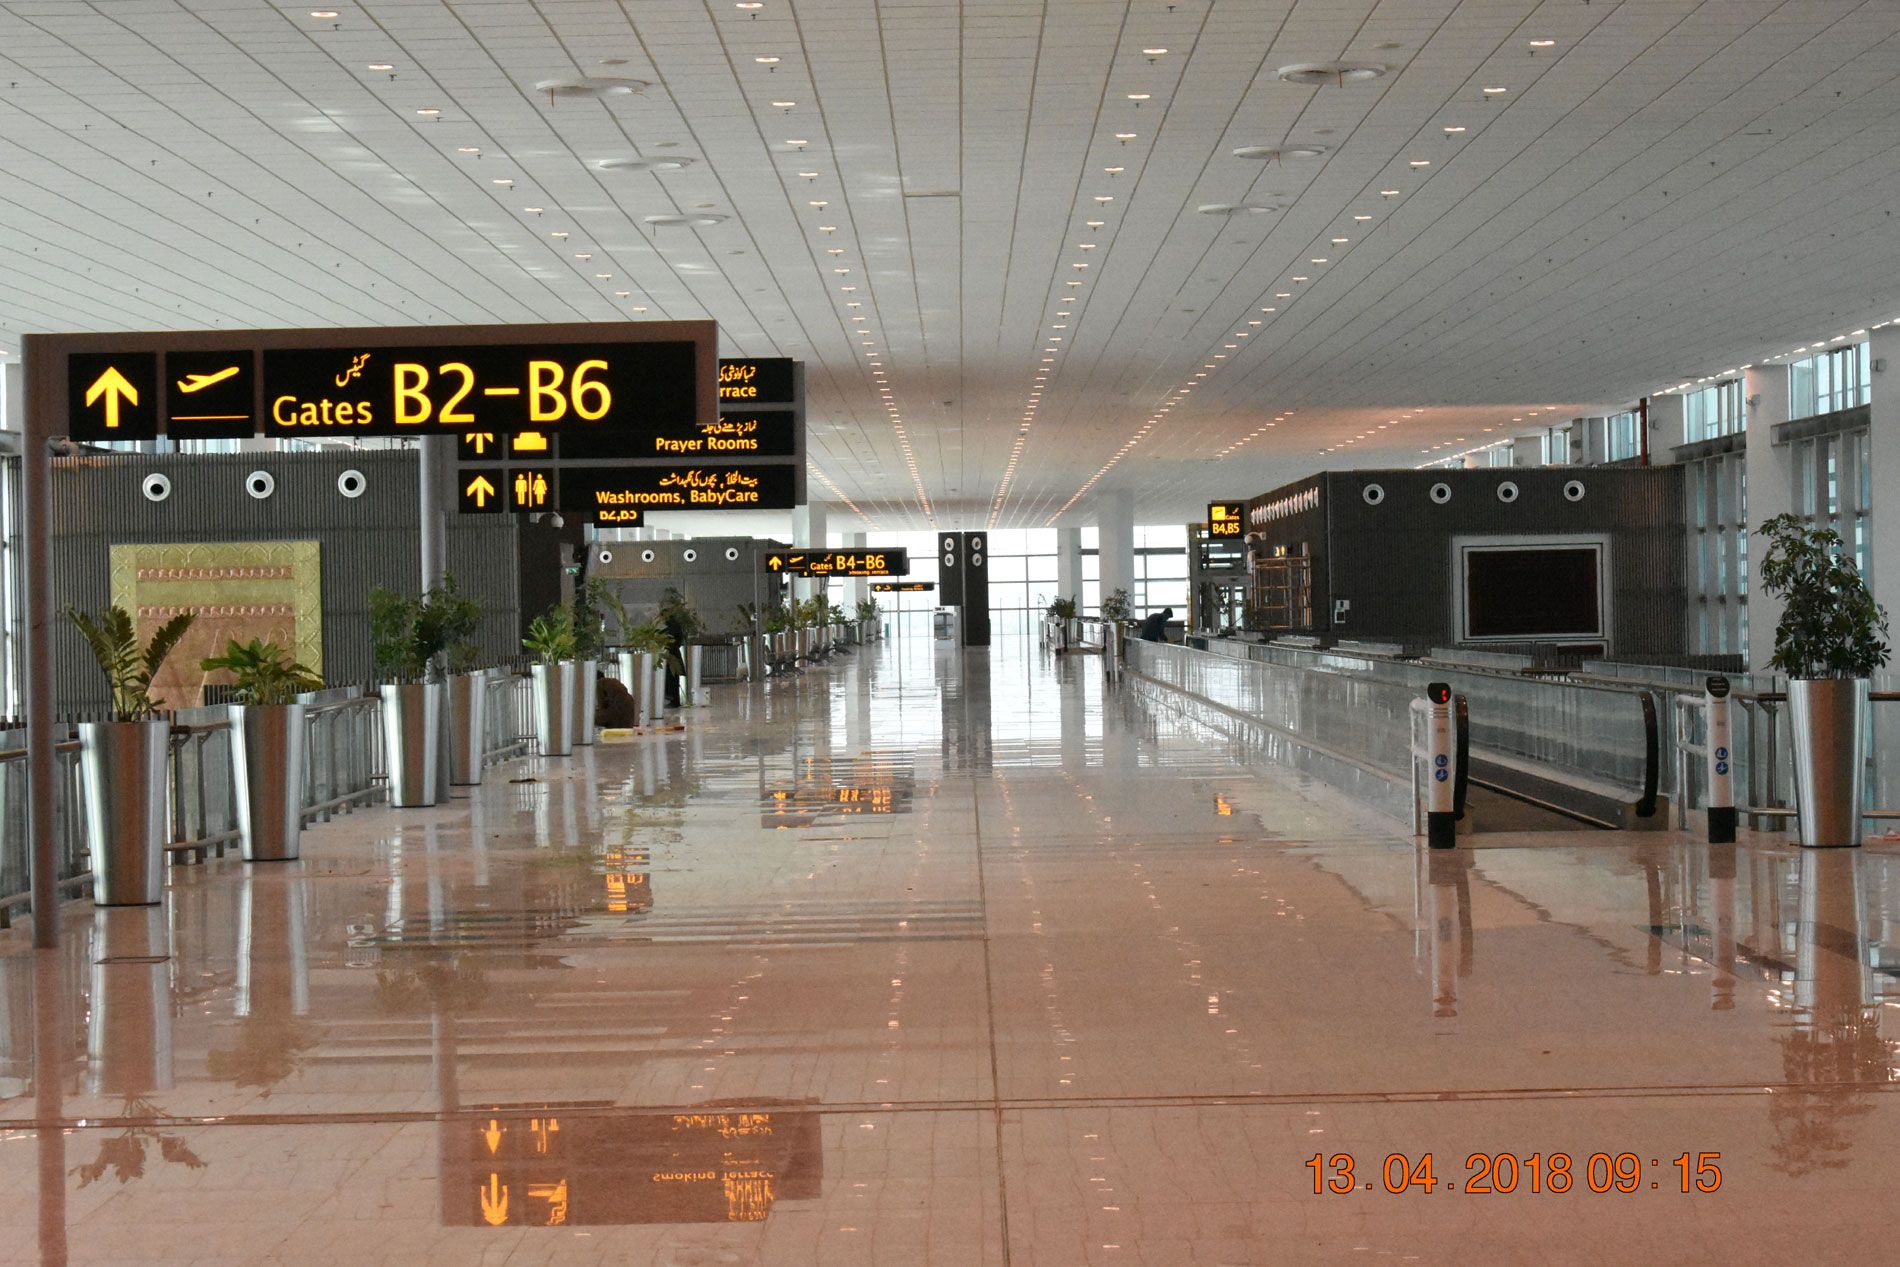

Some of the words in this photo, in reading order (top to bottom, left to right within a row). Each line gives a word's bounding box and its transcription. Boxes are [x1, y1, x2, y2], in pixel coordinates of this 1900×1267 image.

[272, 395, 373, 426] Gates
[393, 359, 612, 425] B2-B6
[719, 386, 757, 398] rrace
[655, 437, 704, 452] Prayer
[707, 437, 758, 450] Rooms
[596, 490, 686, 505] Washrooms,
[690, 489, 759, 505] BabyCare
[1212, 522, 1240, 536] B4,B5
[810, 562, 833, 571] Gates
[836, 554, 886, 570] B4-B6
